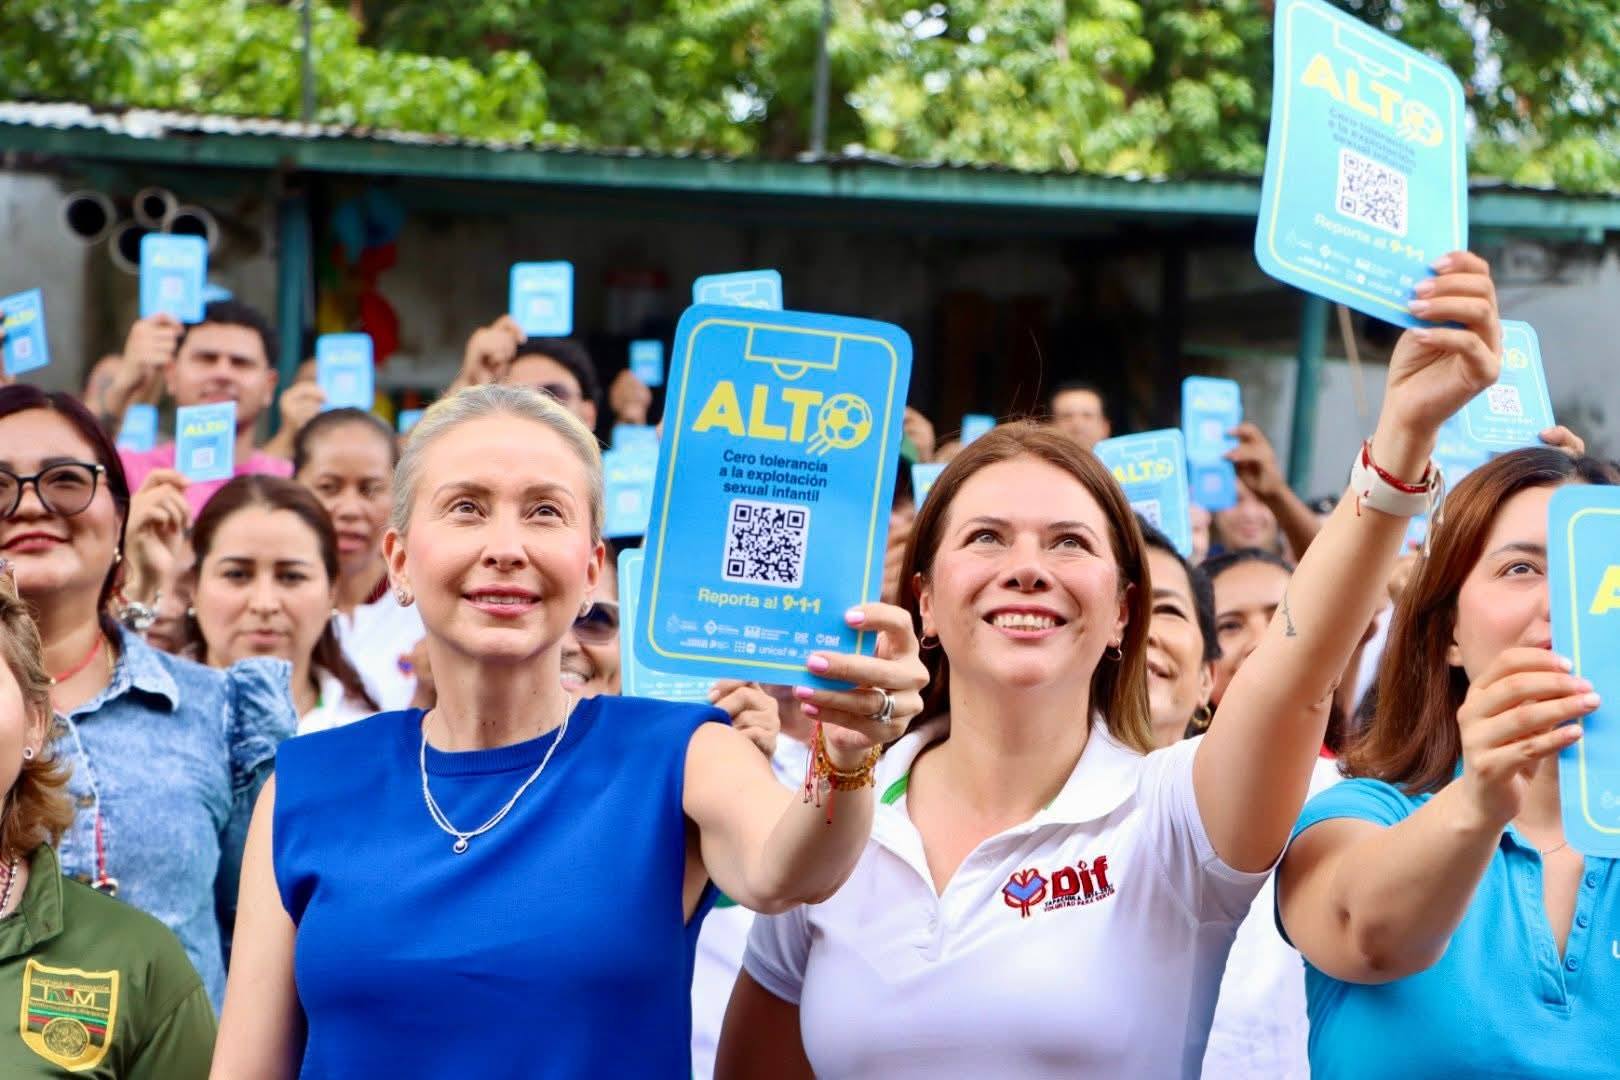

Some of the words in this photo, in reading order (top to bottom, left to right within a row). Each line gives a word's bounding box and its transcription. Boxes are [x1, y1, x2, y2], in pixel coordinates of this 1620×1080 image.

[692, 381, 873, 453] ALTO
[723, 449, 756, 465] Cero
[760, 454, 828, 473] tolerancia
[719, 466, 728, 477] a
[731, 465, 743, 478] la
[747, 469, 827, 488] explotación
[723, 482, 768, 497] sexual
[772, 486, 820, 503] infantil
[698, 588, 760, 608] Reporta
[763, 597, 778, 610] al
[782, 594, 822, 614] 9-1-1
